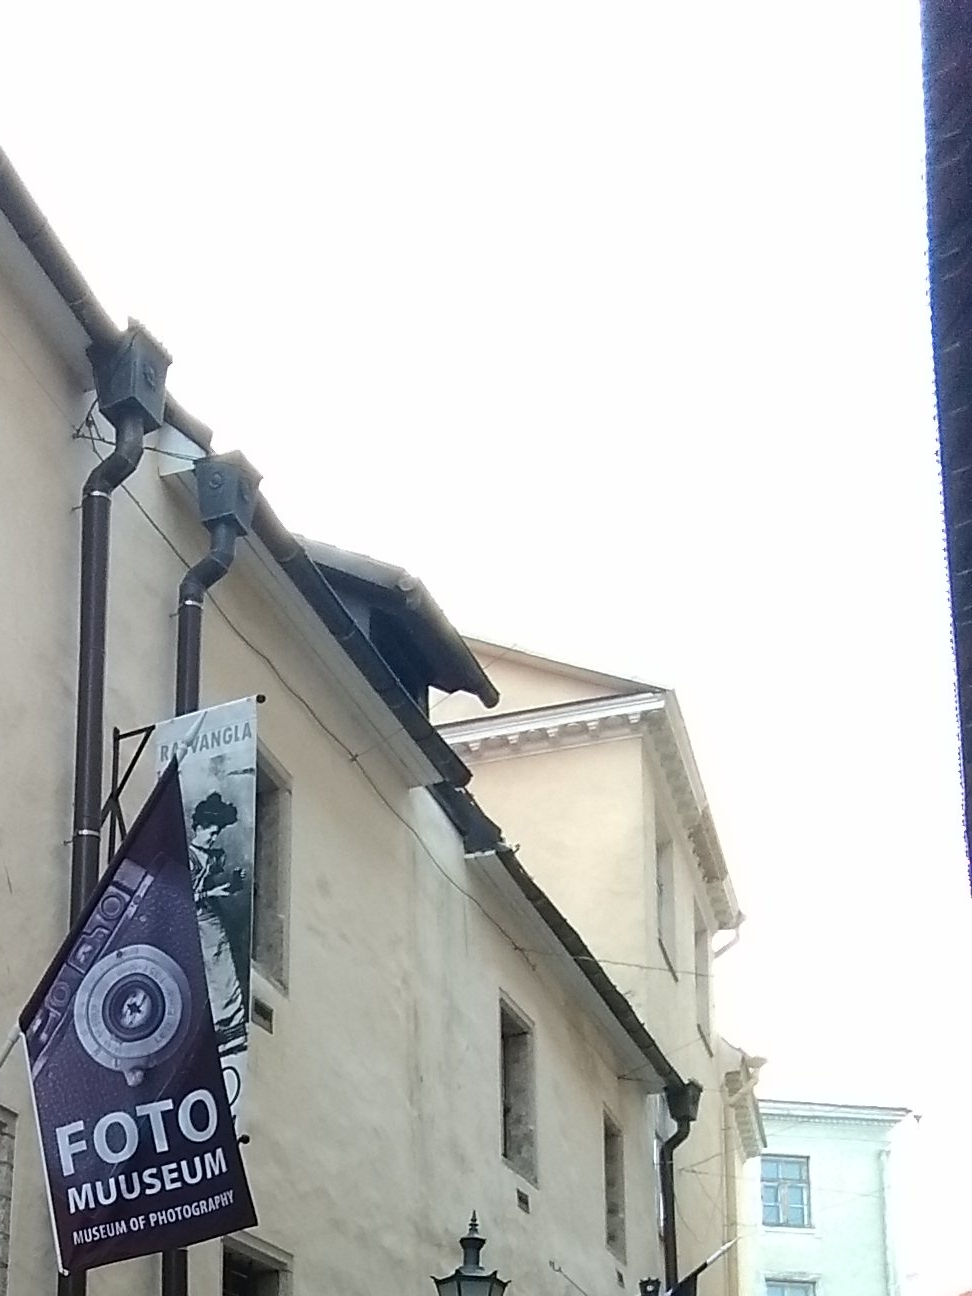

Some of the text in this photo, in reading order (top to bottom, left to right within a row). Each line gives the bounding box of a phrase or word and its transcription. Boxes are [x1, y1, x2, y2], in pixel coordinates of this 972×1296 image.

[159, 721, 253, 763] RAVANGLA
[55, 1089, 218, 1177] FOTO
[67, 1147, 228, 1215] MUUSEUM
[72, 1190, 235, 1246] MUSEUM OF PHOTOGRAPHY
